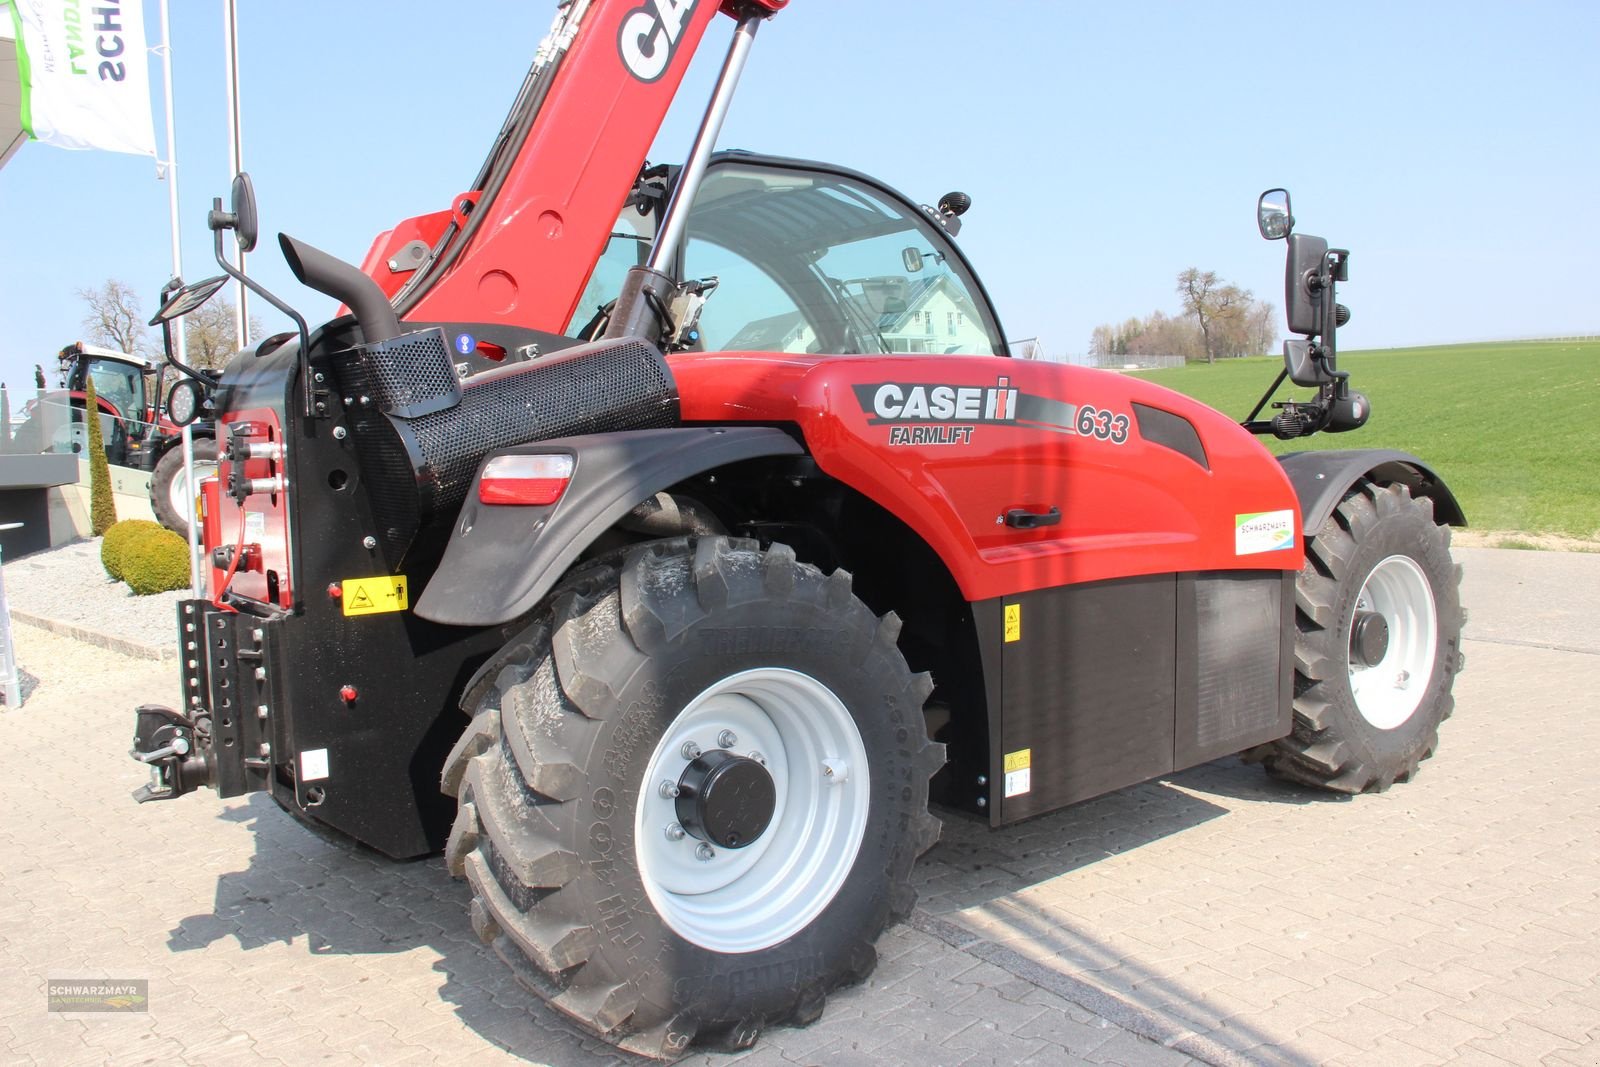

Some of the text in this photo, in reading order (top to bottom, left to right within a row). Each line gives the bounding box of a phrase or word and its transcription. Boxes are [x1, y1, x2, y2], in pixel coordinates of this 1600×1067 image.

[873, 383, 981, 420] CASE
[888, 426, 974, 446] FARMLIFT
[1076, 405, 1129, 444] 633
